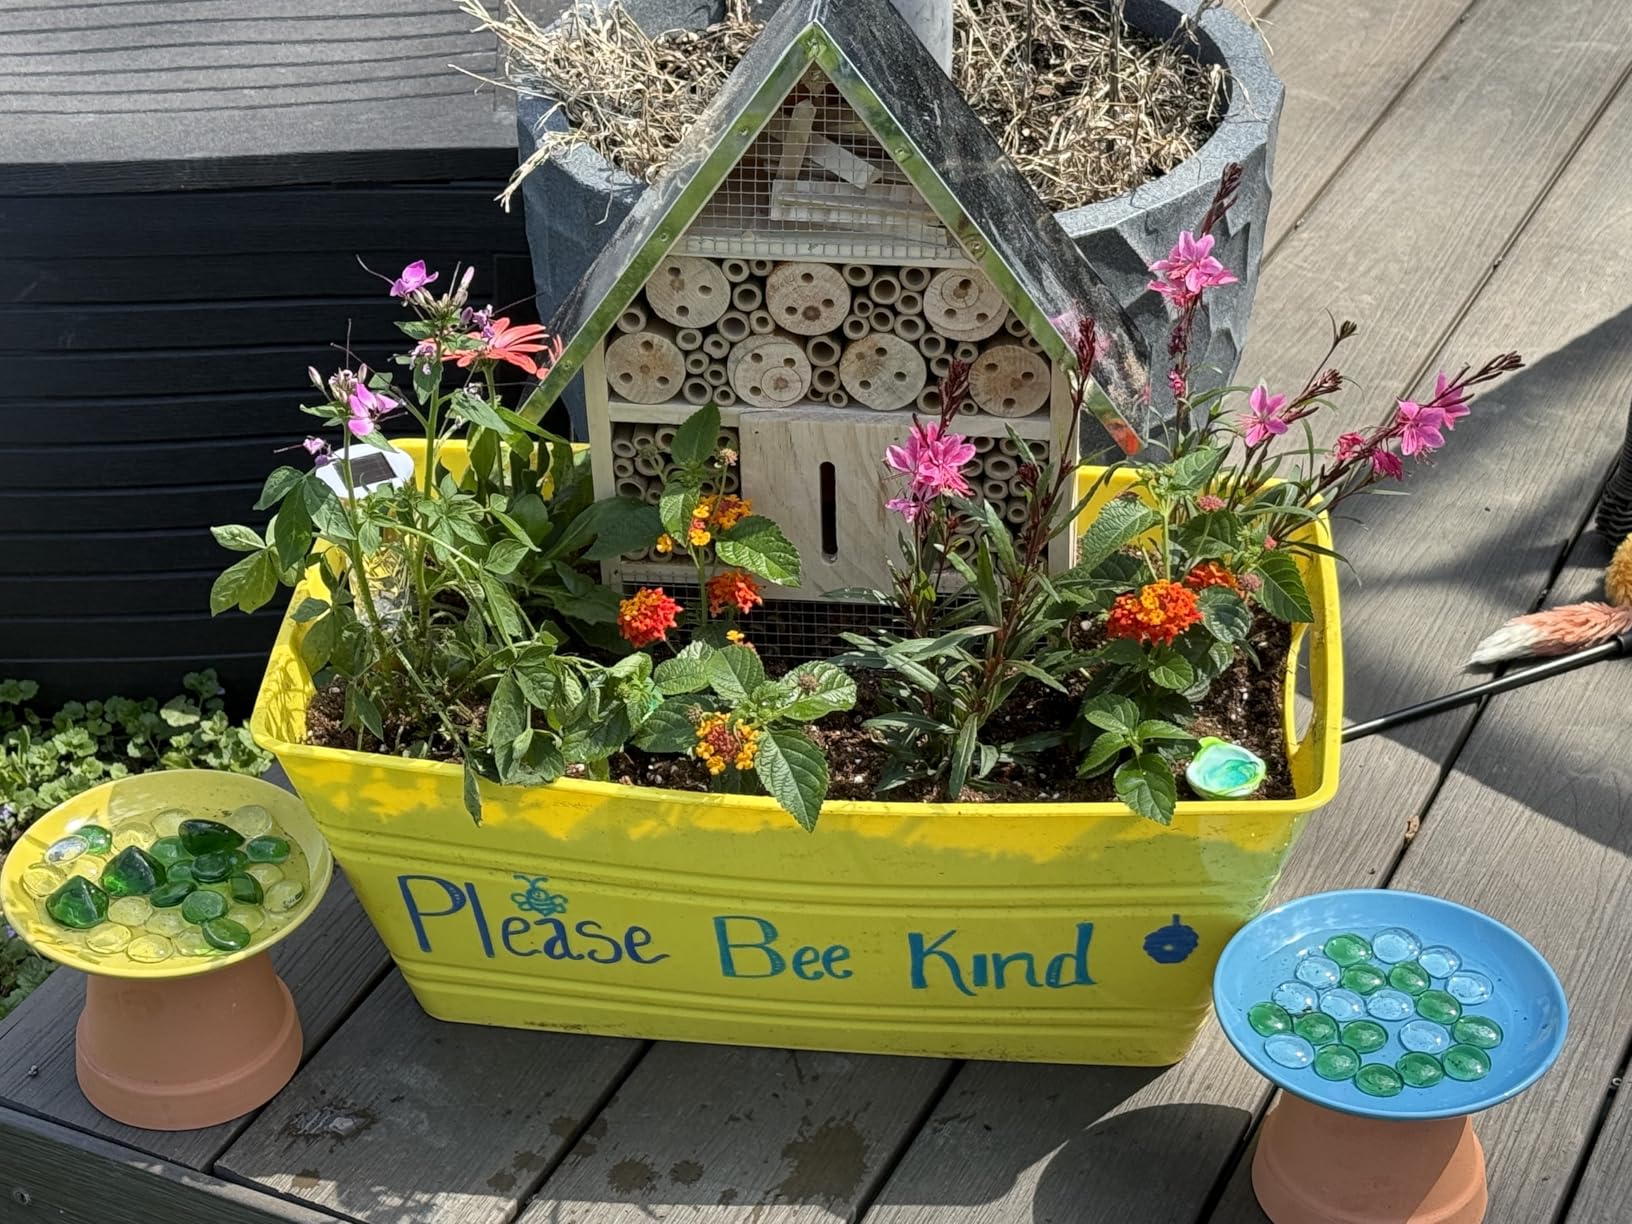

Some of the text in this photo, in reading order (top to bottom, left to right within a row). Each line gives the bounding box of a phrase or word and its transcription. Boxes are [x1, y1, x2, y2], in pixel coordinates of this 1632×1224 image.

[396, 875, 1097, 996] Please Bee Kind
